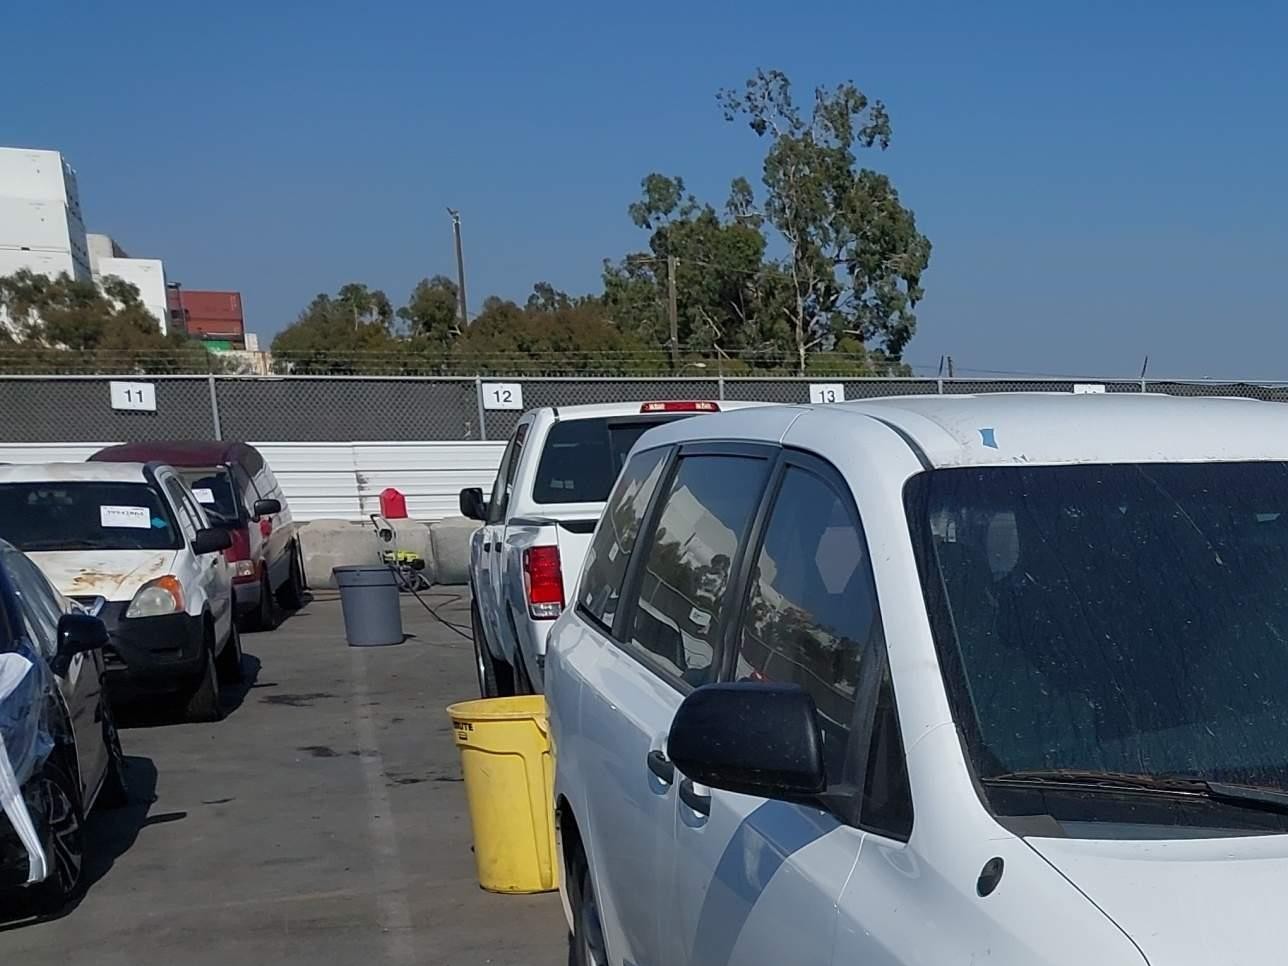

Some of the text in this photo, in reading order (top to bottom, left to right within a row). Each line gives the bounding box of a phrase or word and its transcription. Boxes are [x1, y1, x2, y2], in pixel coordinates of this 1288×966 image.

[123, 389, 144, 403] 11
[493, 390, 513, 403] 12
[819, 390, 835, 403] 13
